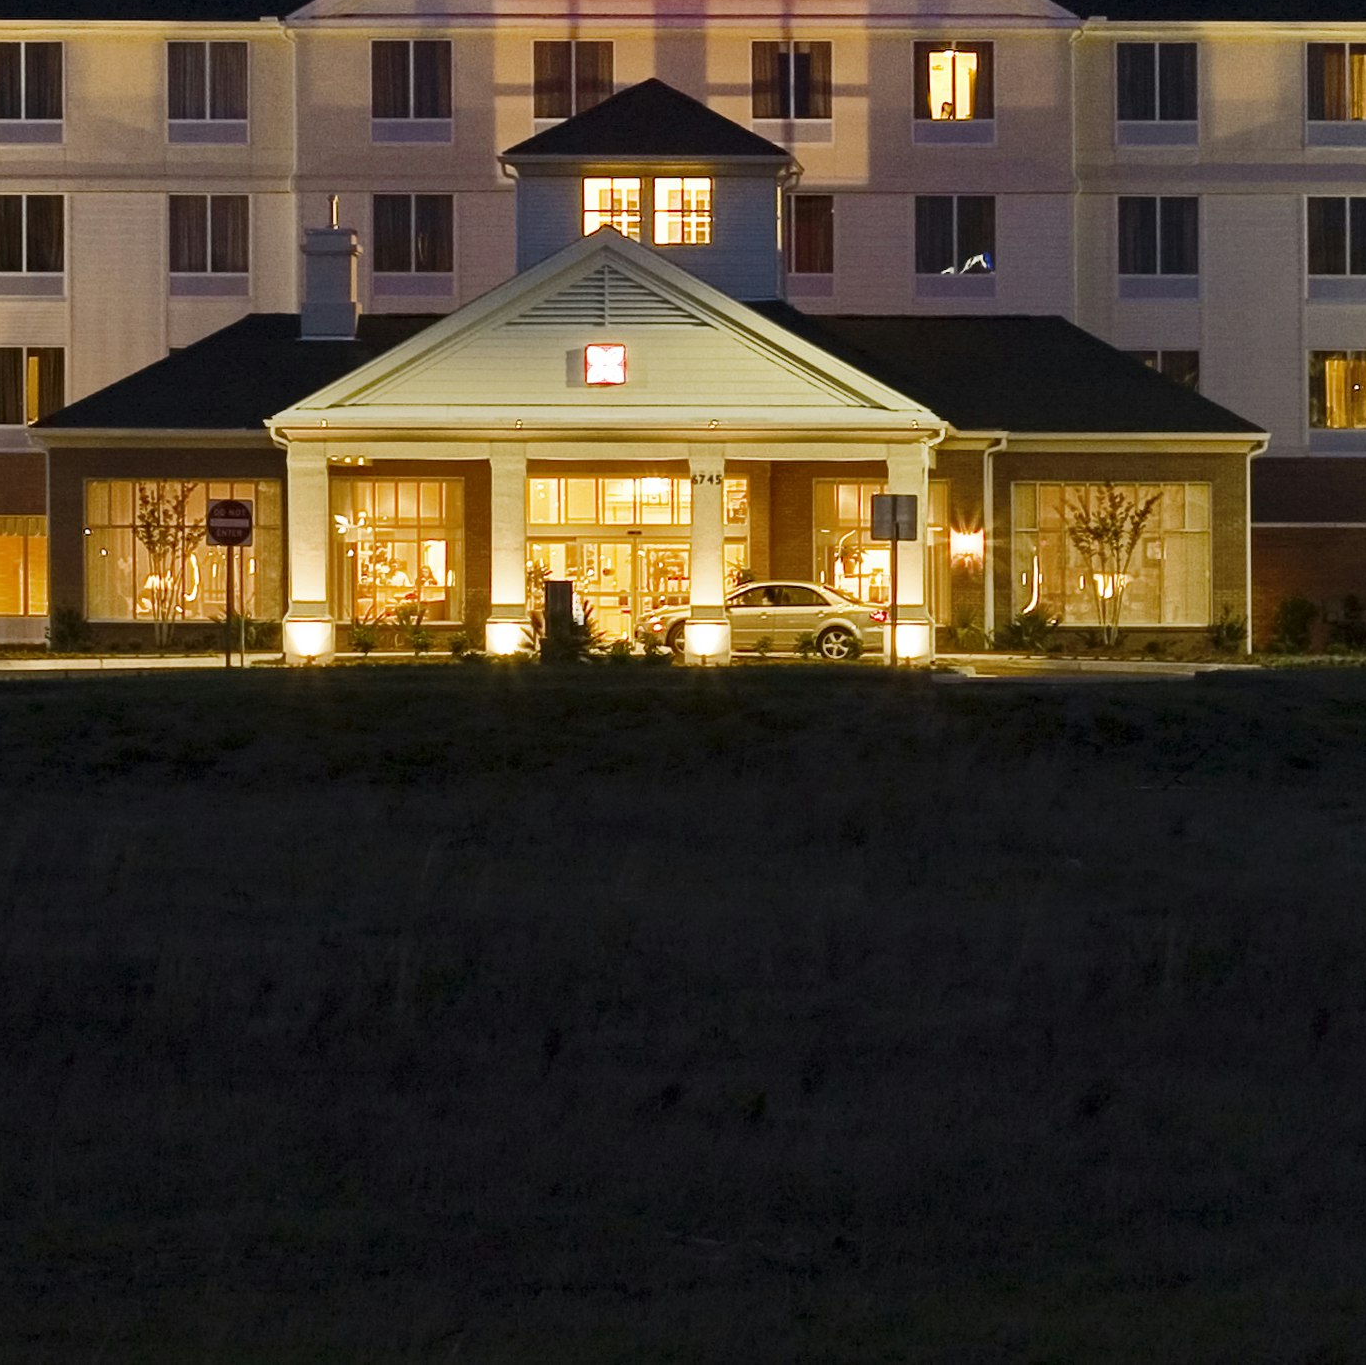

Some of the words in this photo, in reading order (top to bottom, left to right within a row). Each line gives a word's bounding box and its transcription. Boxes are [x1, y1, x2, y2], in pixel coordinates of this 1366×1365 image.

[691, 474, 722, 485] 6745
[213, 508, 226, 517] DO
[228, 508, 247, 517] NOT
[216, 528, 243, 538] ENTER
